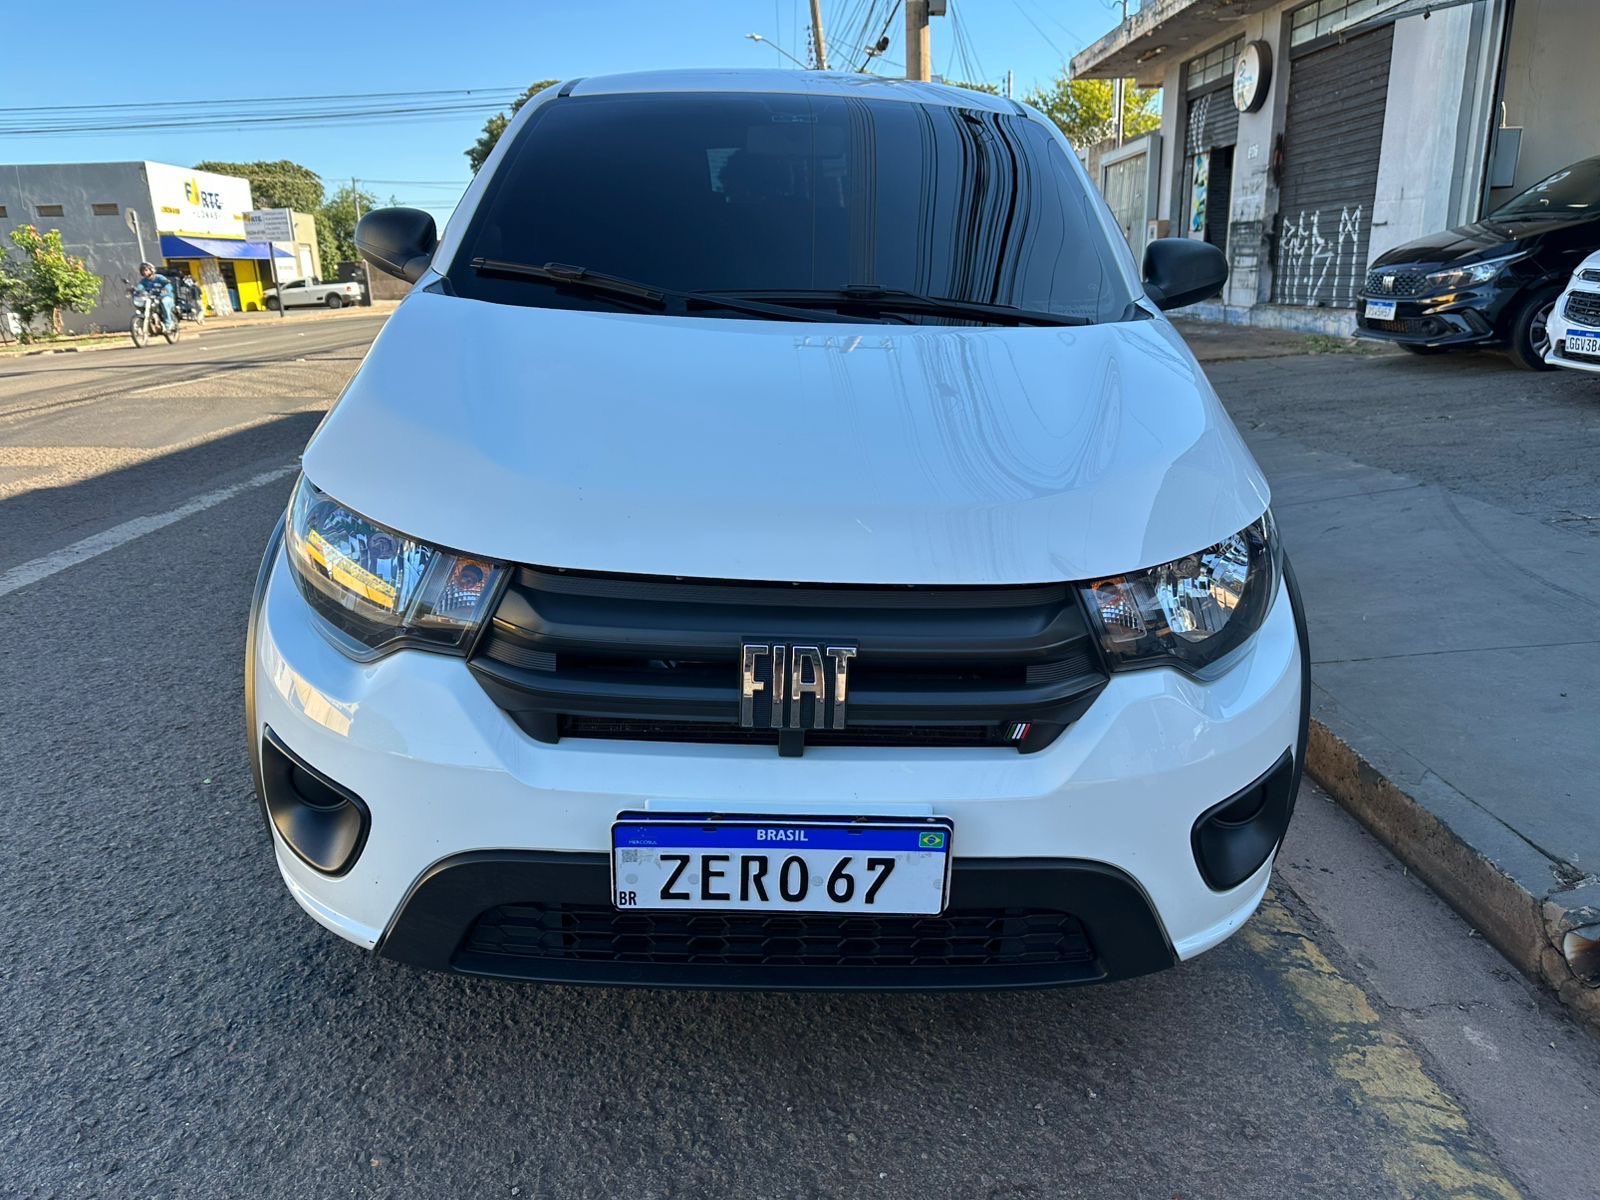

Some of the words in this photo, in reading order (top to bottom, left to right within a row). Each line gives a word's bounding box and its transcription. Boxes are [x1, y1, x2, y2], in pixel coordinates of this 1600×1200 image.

[741, 644, 857, 728] FIAT
[756, 829, 809, 842] BRASIL
[826, 856, 896, 905] 67
[619, 891, 637, 906] BR
